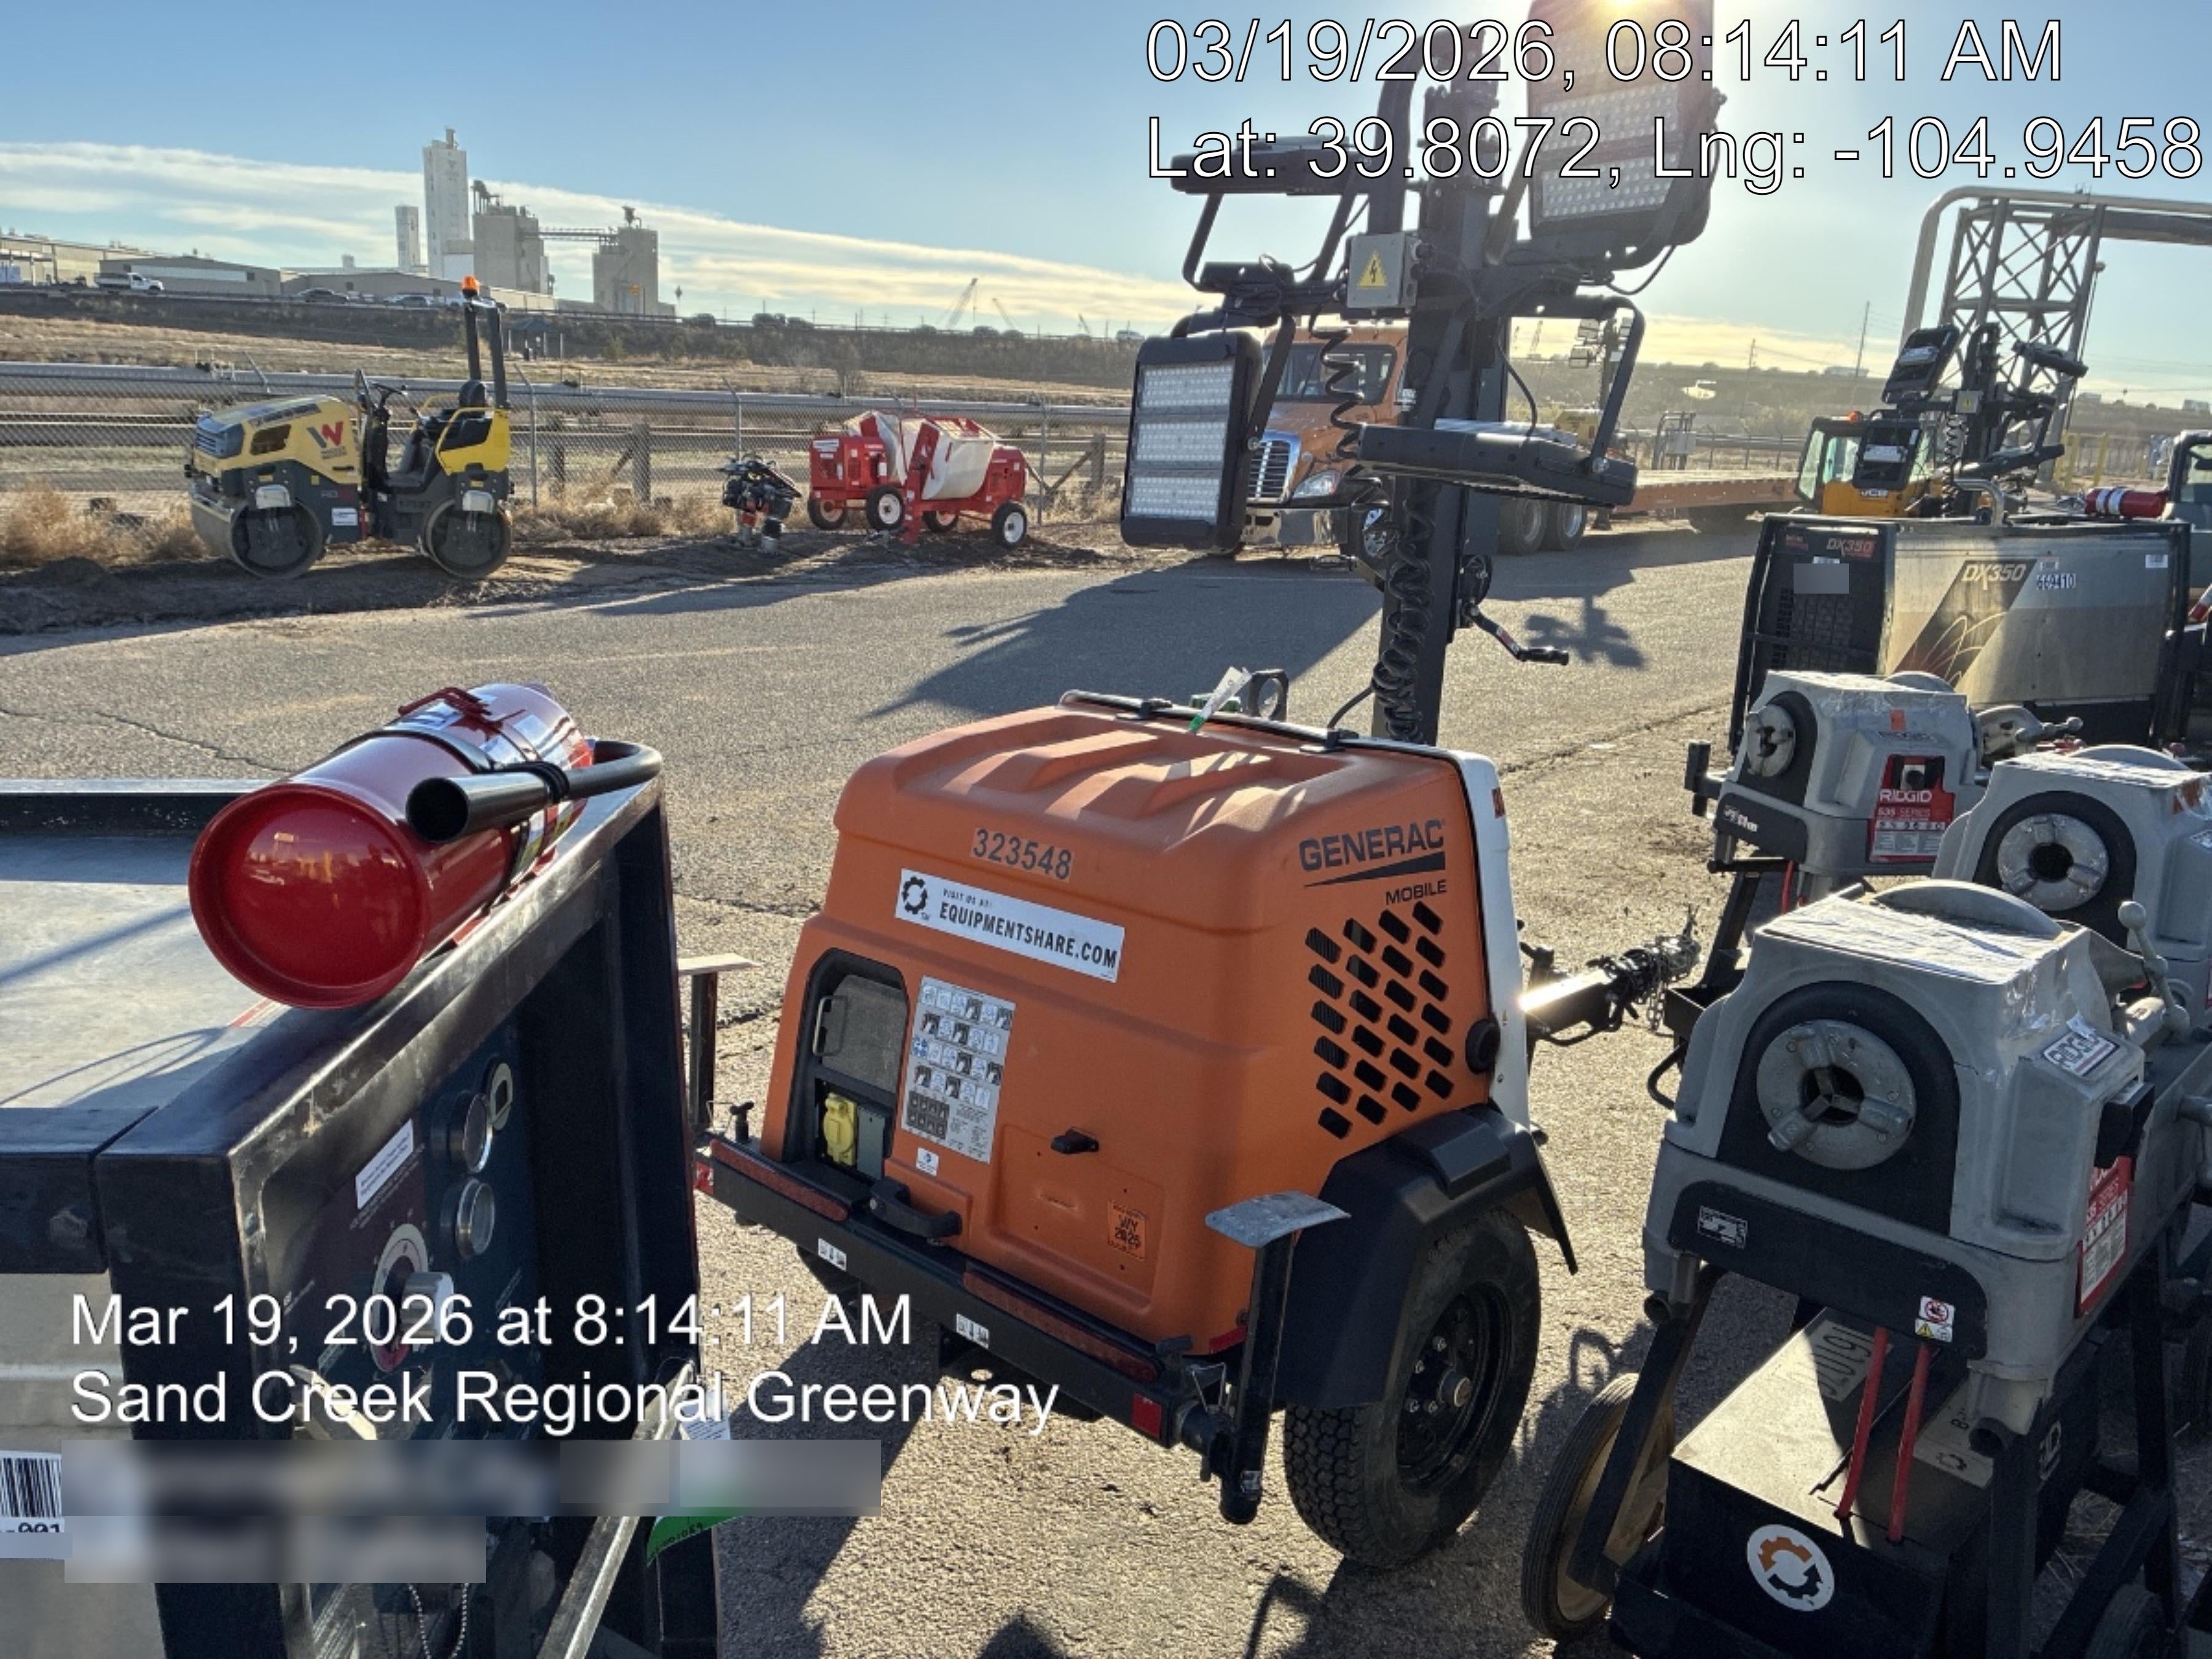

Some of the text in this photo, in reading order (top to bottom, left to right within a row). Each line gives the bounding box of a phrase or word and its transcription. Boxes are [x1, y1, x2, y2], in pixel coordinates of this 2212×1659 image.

[1961, 563, 2026, 590] DX350
[1880, 788, 1932, 802] RIDGID
[973, 828, 1073, 880] 323548
[1299, 818, 1445, 871] GENERAC
[1386, 879, 1447, 905] MOBILE
[939, 901, 1118, 969] EQUIPMENTSHARE.COM
